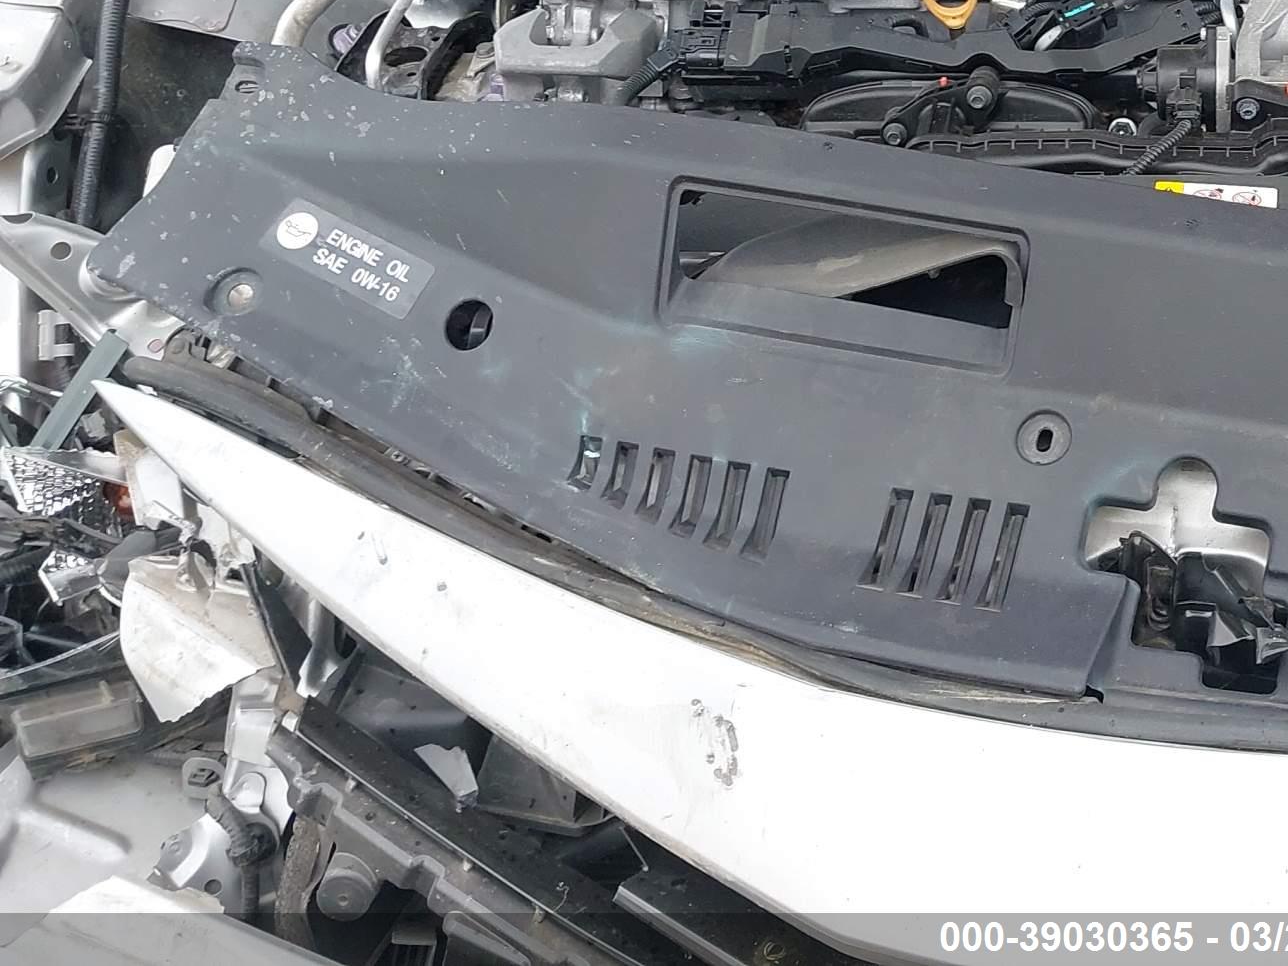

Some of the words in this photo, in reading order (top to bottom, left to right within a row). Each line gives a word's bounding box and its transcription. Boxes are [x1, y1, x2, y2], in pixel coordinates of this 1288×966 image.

[312, 248, 349, 275] SAE
[351, 267, 401, 302] 0W-16
[325, 228, 385, 267] ENGINE
[385, 259, 411, 283] OIL
